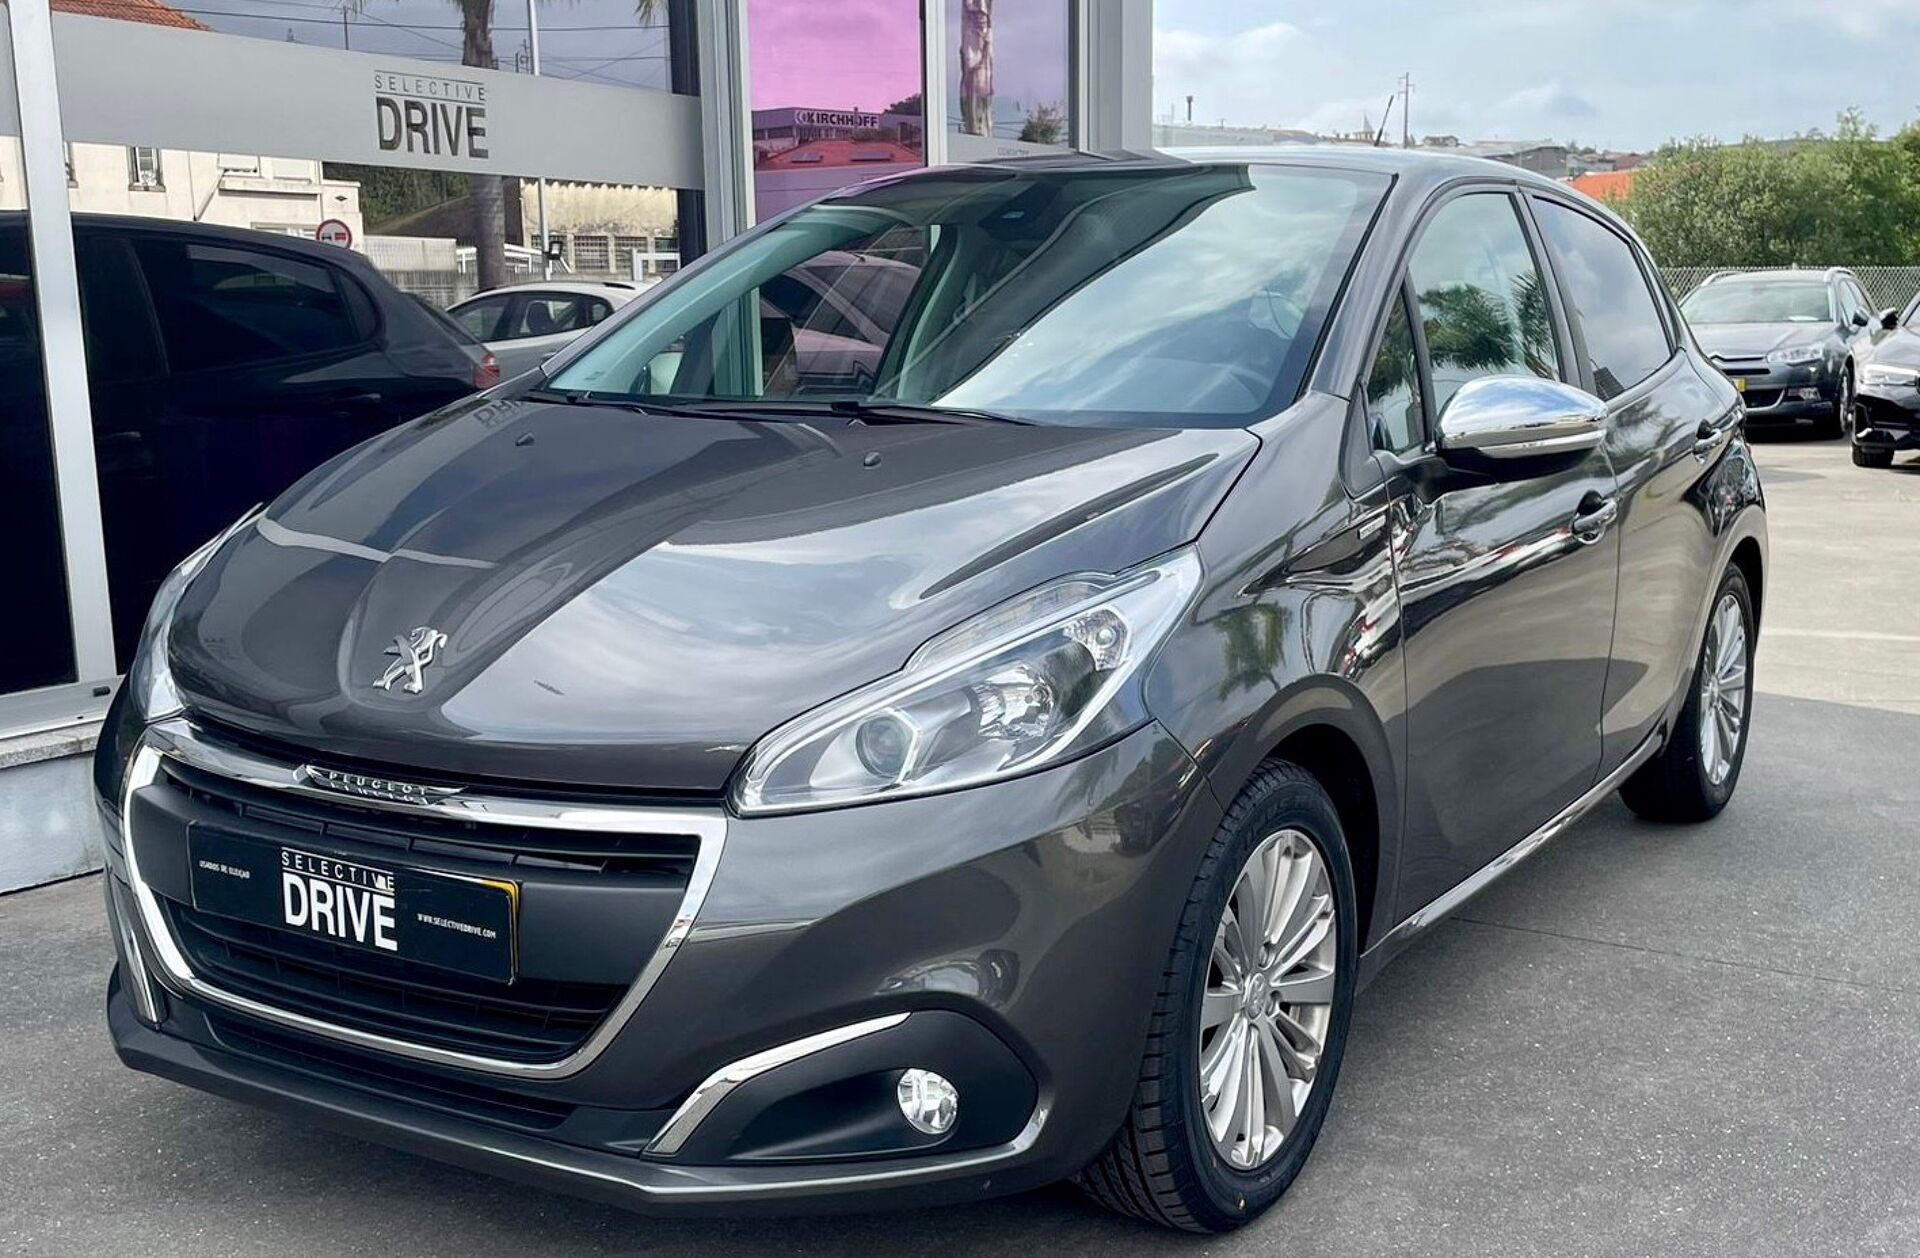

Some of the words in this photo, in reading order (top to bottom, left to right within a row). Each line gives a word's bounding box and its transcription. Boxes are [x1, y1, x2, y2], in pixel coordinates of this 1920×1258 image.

[374, 74, 487, 101] SELECTIVE
[376, 96, 489, 159] DRIVE
[281, 851, 395, 892] SELECTIVE
[282, 872, 398, 951] DRIVE
